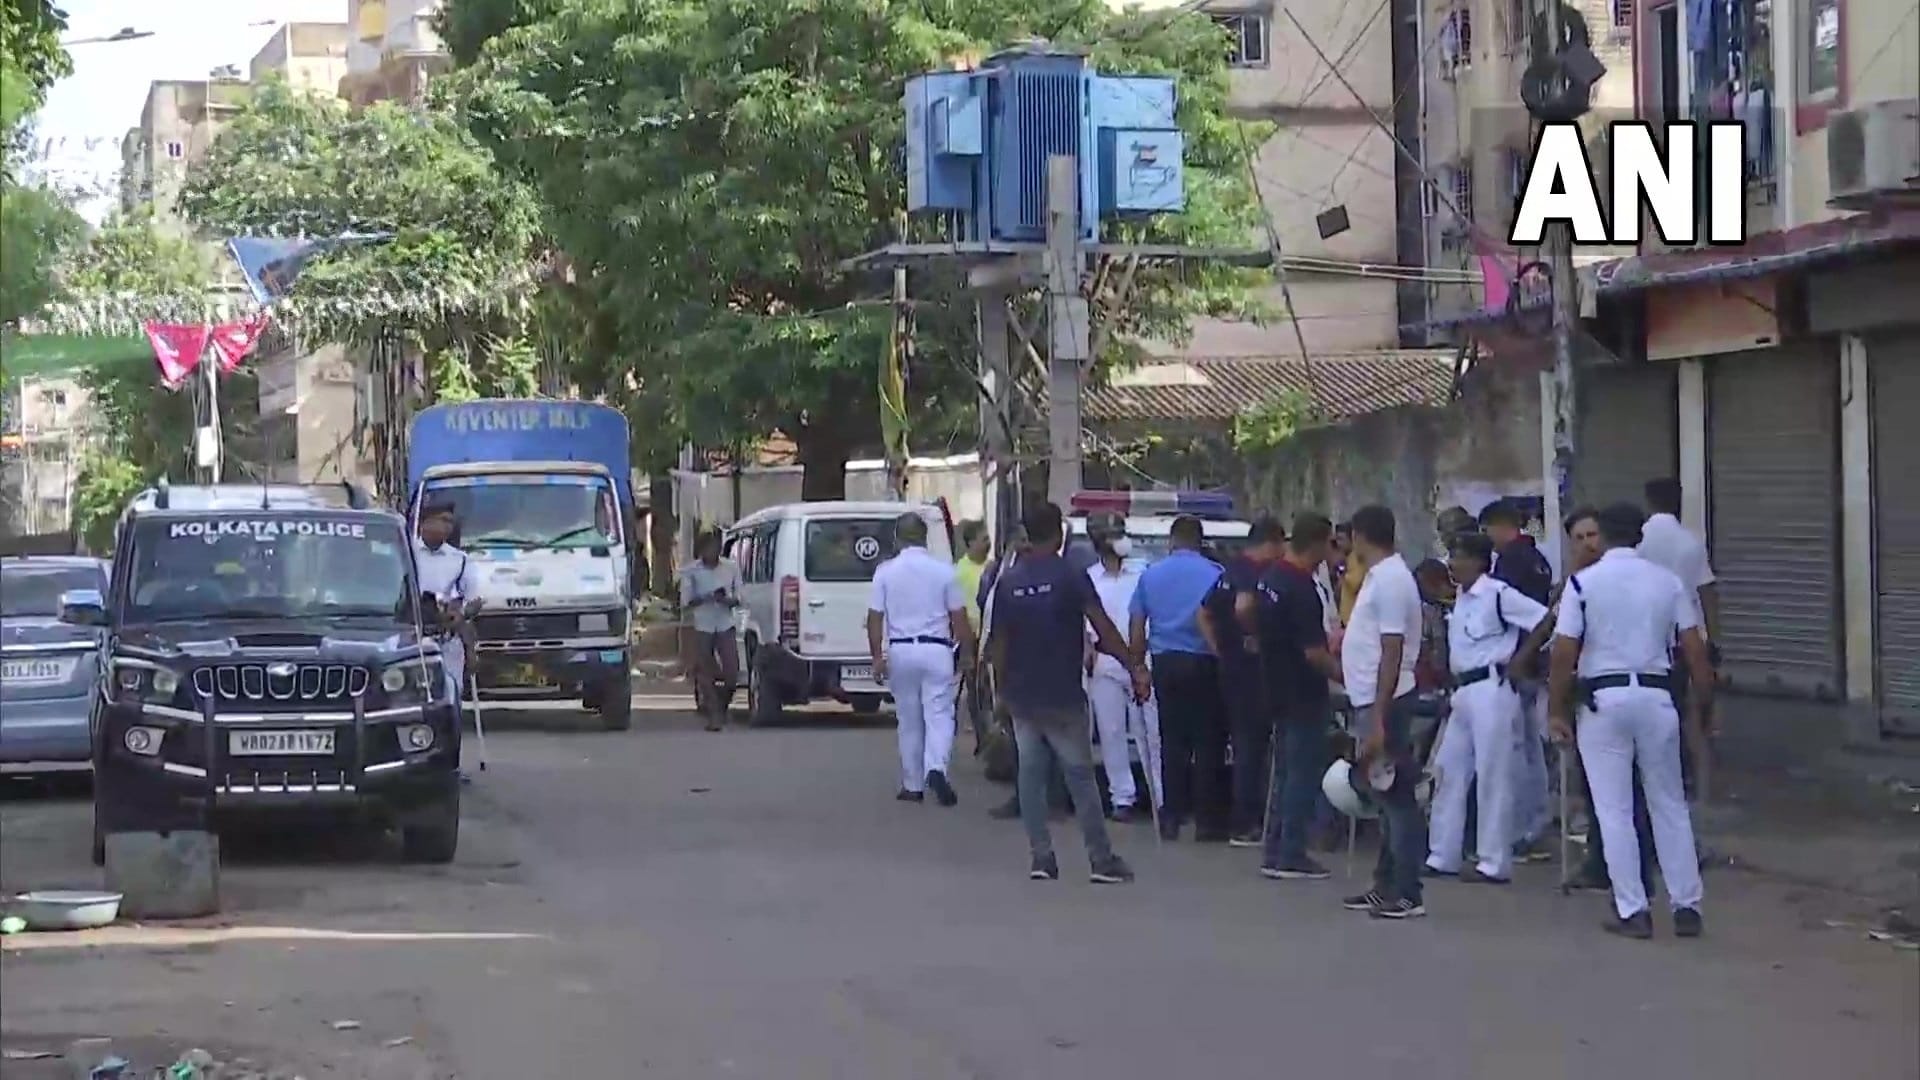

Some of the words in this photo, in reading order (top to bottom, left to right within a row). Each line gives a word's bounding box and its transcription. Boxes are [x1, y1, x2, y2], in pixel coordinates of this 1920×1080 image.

[170, 519, 280, 538] KOLKATA
[282, 520, 366, 539] POLICE
[860, 541, 876, 556] KP
[505, 597, 537, 607] TATA
